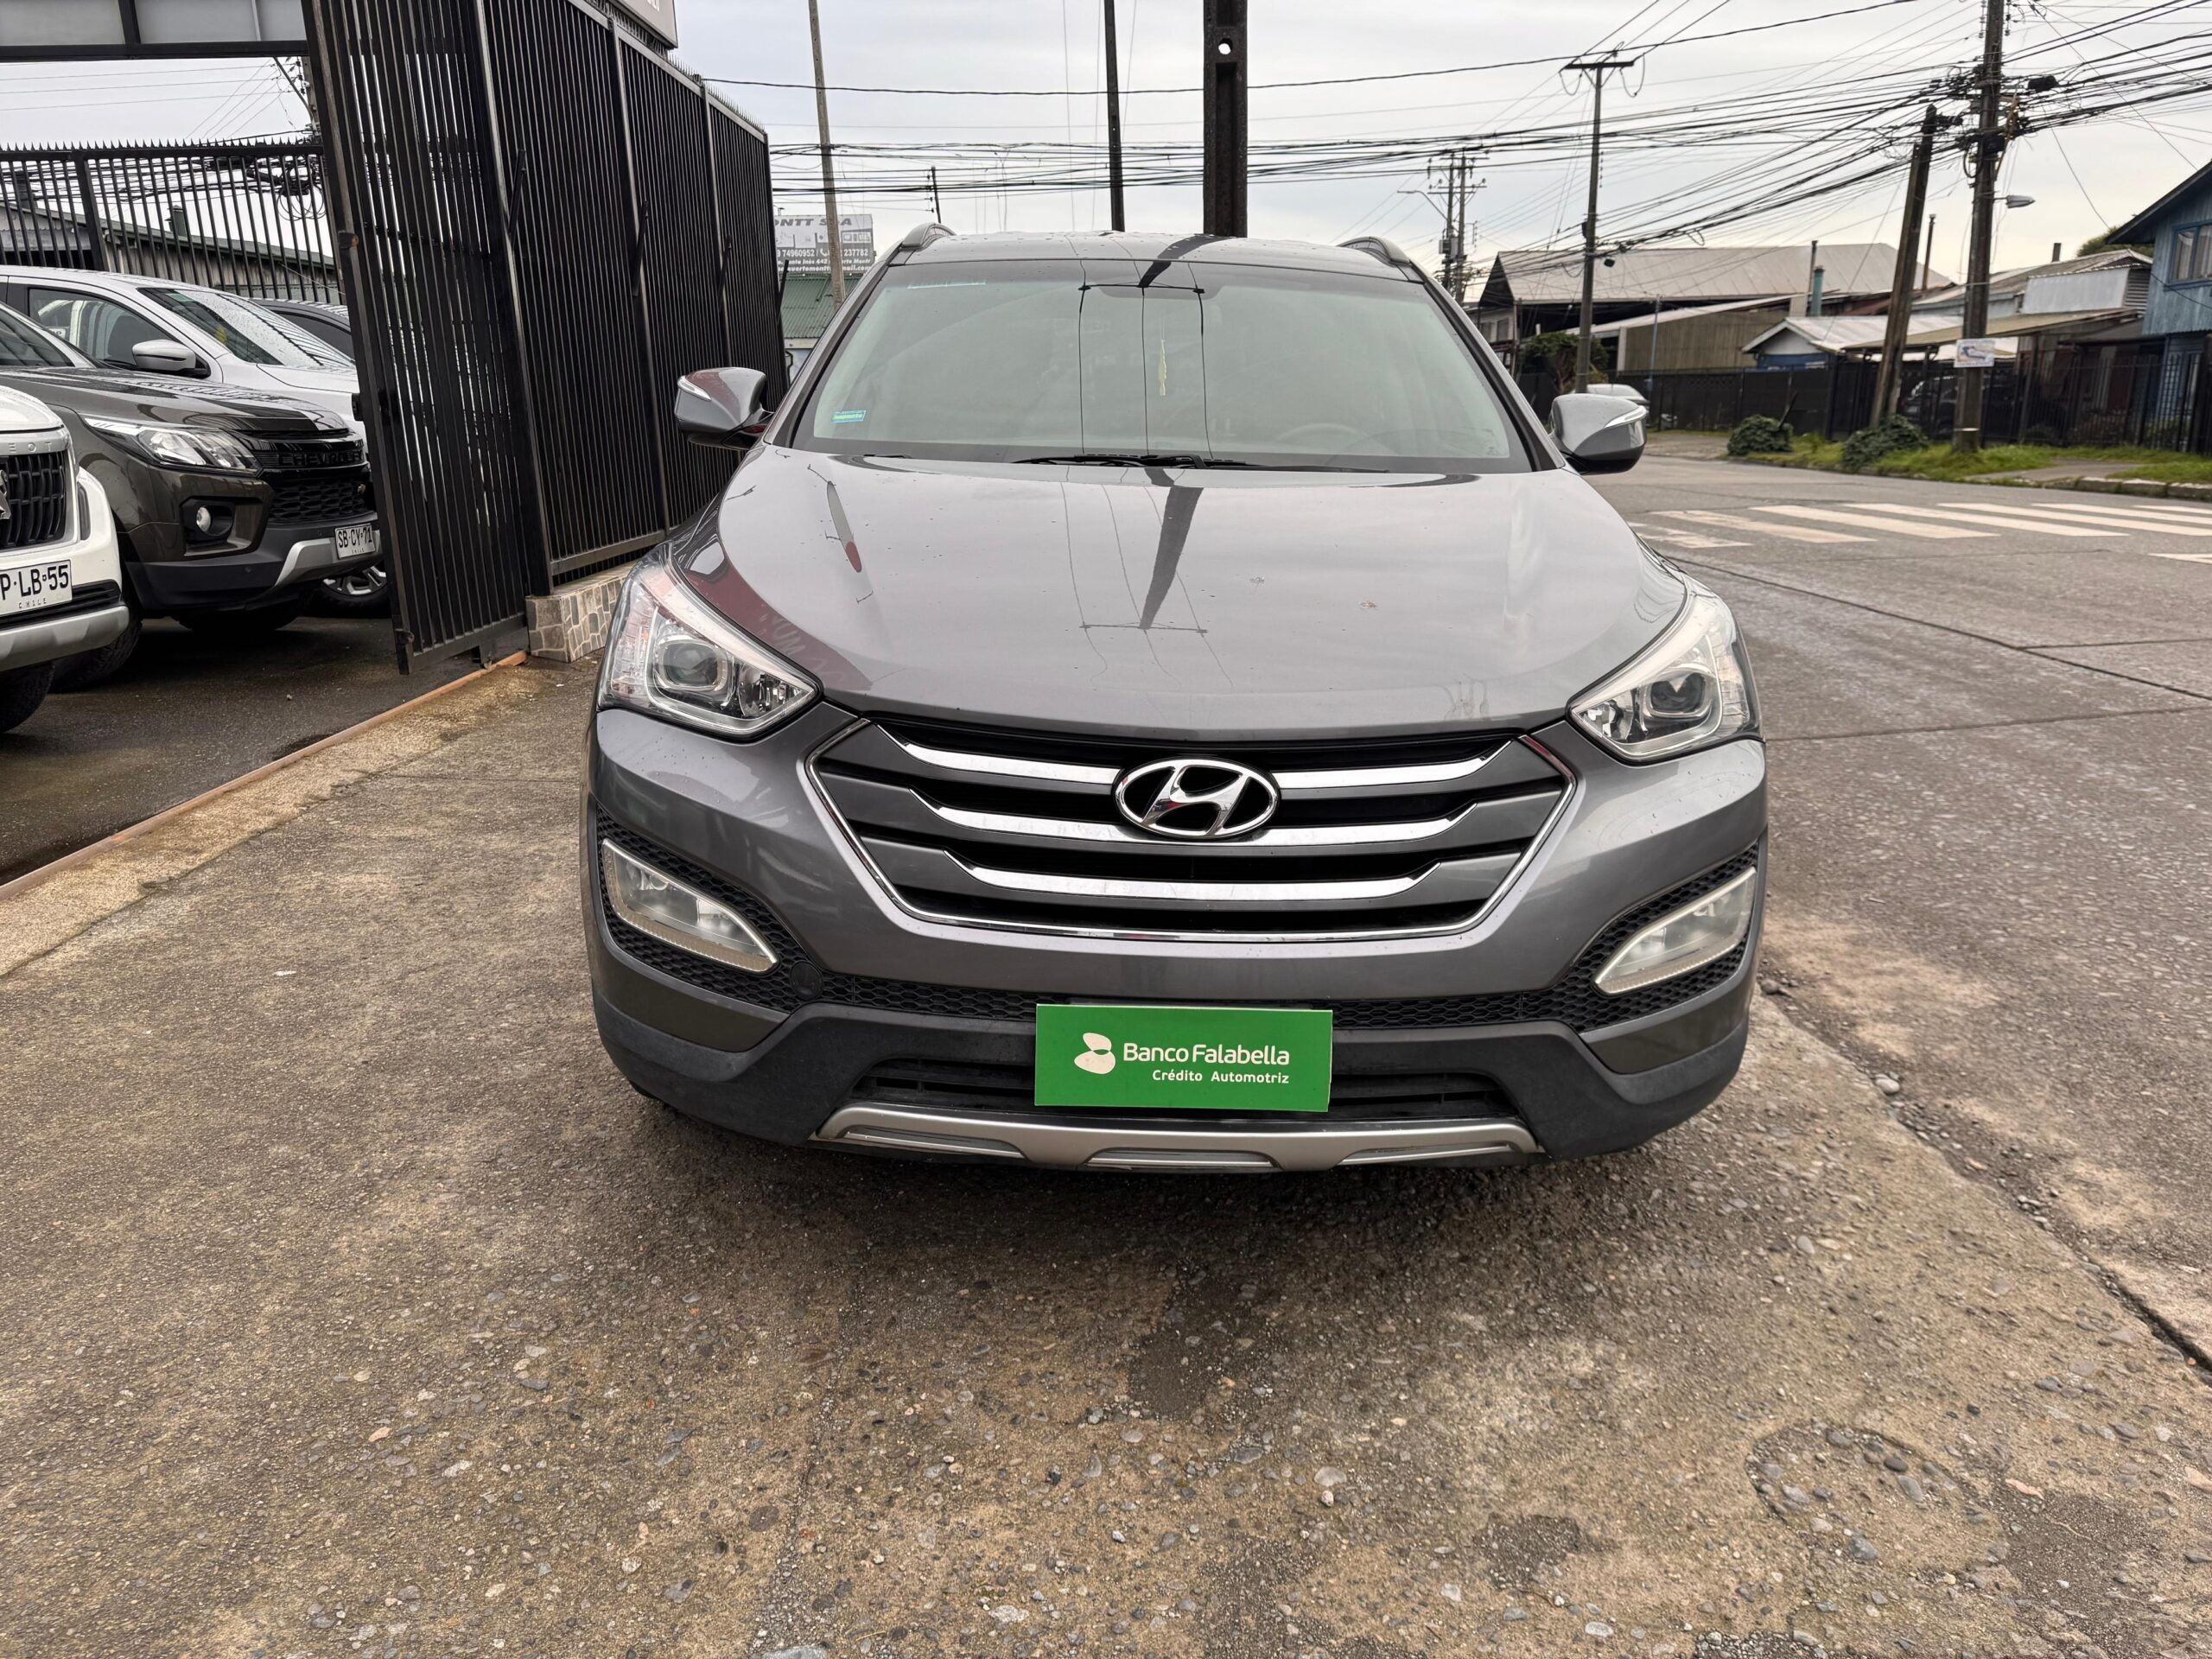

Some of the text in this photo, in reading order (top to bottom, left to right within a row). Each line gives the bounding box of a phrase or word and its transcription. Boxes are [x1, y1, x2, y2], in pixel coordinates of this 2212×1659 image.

[18, 597, 47, 609] CHILE
[1123, 1042, 1290, 1065] Banco Falabella
[1152, 1069, 1290, 1084] Crédito Automotriz
